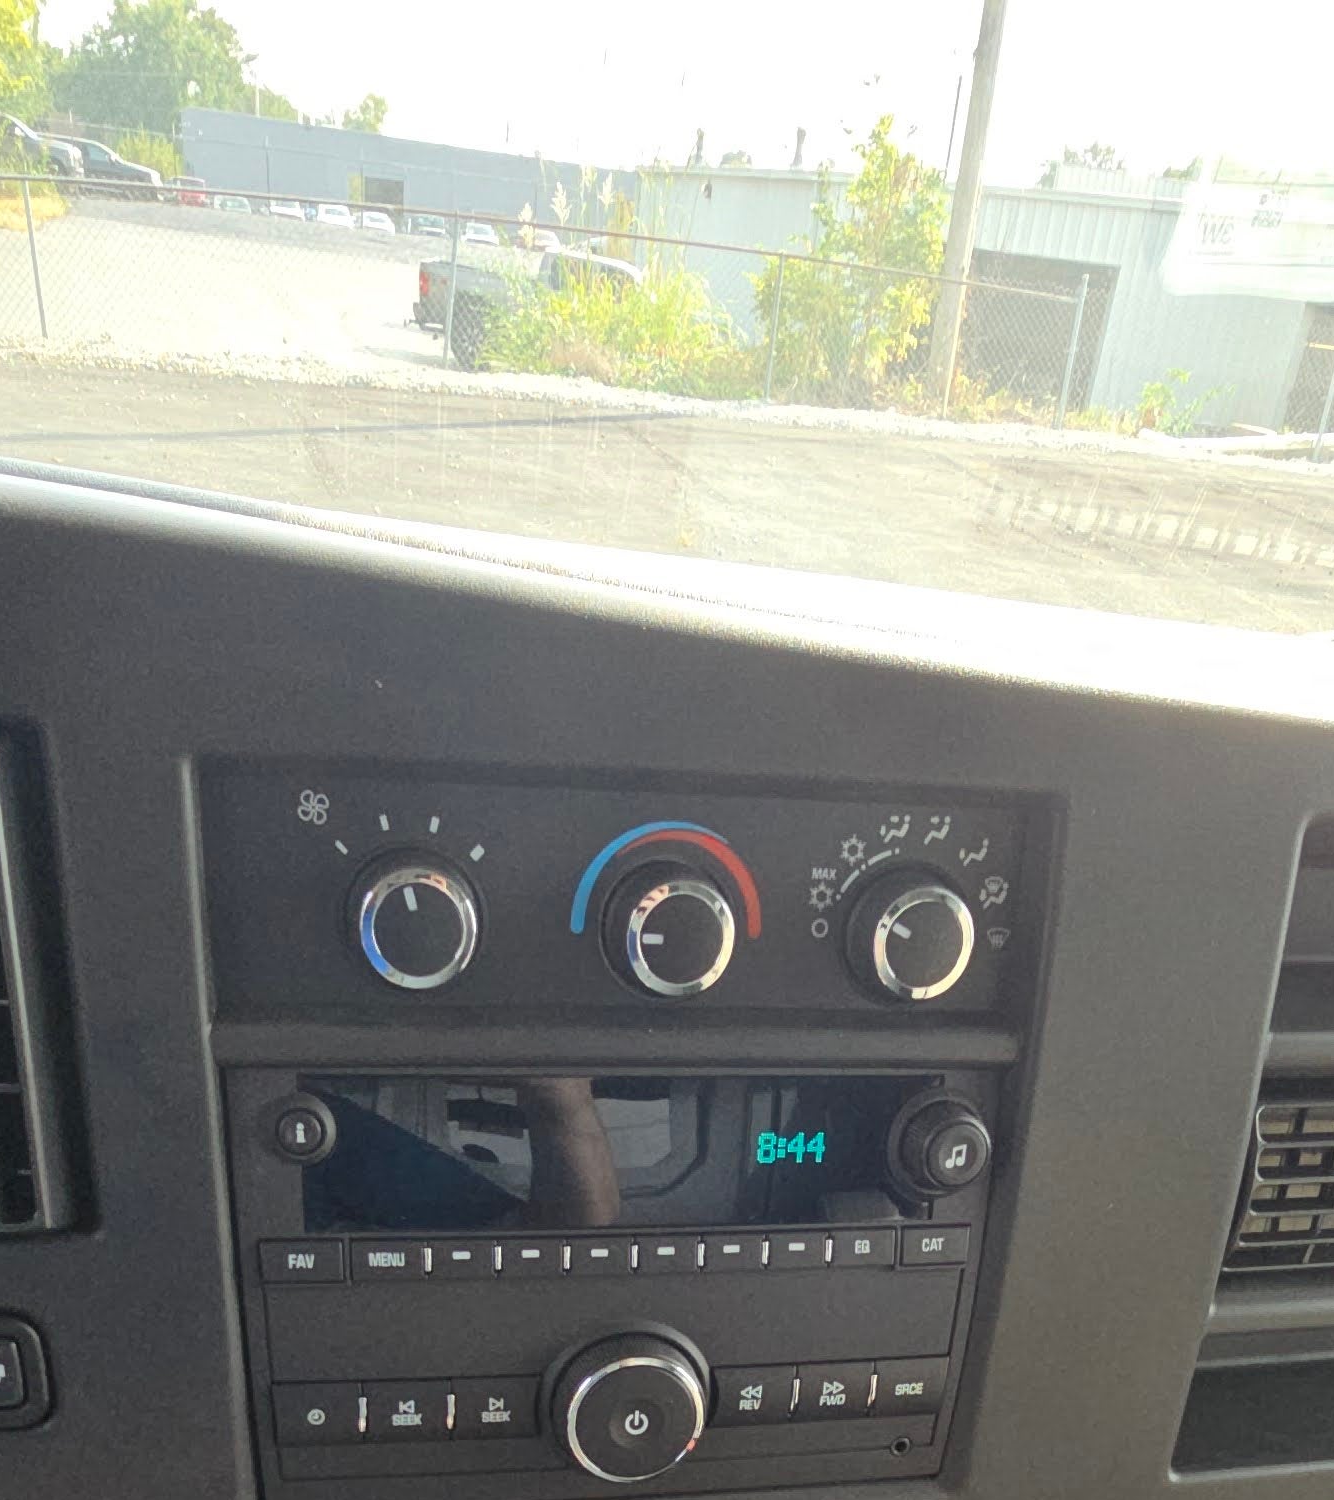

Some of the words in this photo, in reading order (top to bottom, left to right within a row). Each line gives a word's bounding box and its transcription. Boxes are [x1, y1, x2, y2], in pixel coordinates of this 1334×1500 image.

[812, 867, 836, 880] MAX
[757, 1131, 825, 1164] 8:44
[854, 1239, 871, 1254] EQ
[921, 1238, 945, 1252] CAT
[288, 1254, 315, 1269] FAV
[368, 1252, 405, 1267] MENU
[895, 1383, 924, 1396] SRCE
[739, 1400, 762, 1411] REV
[819, 1394, 846, 1406] FWD
[392, 1413, 422, 1426] SEEK
[481, 1411, 511, 1423] SEEK
